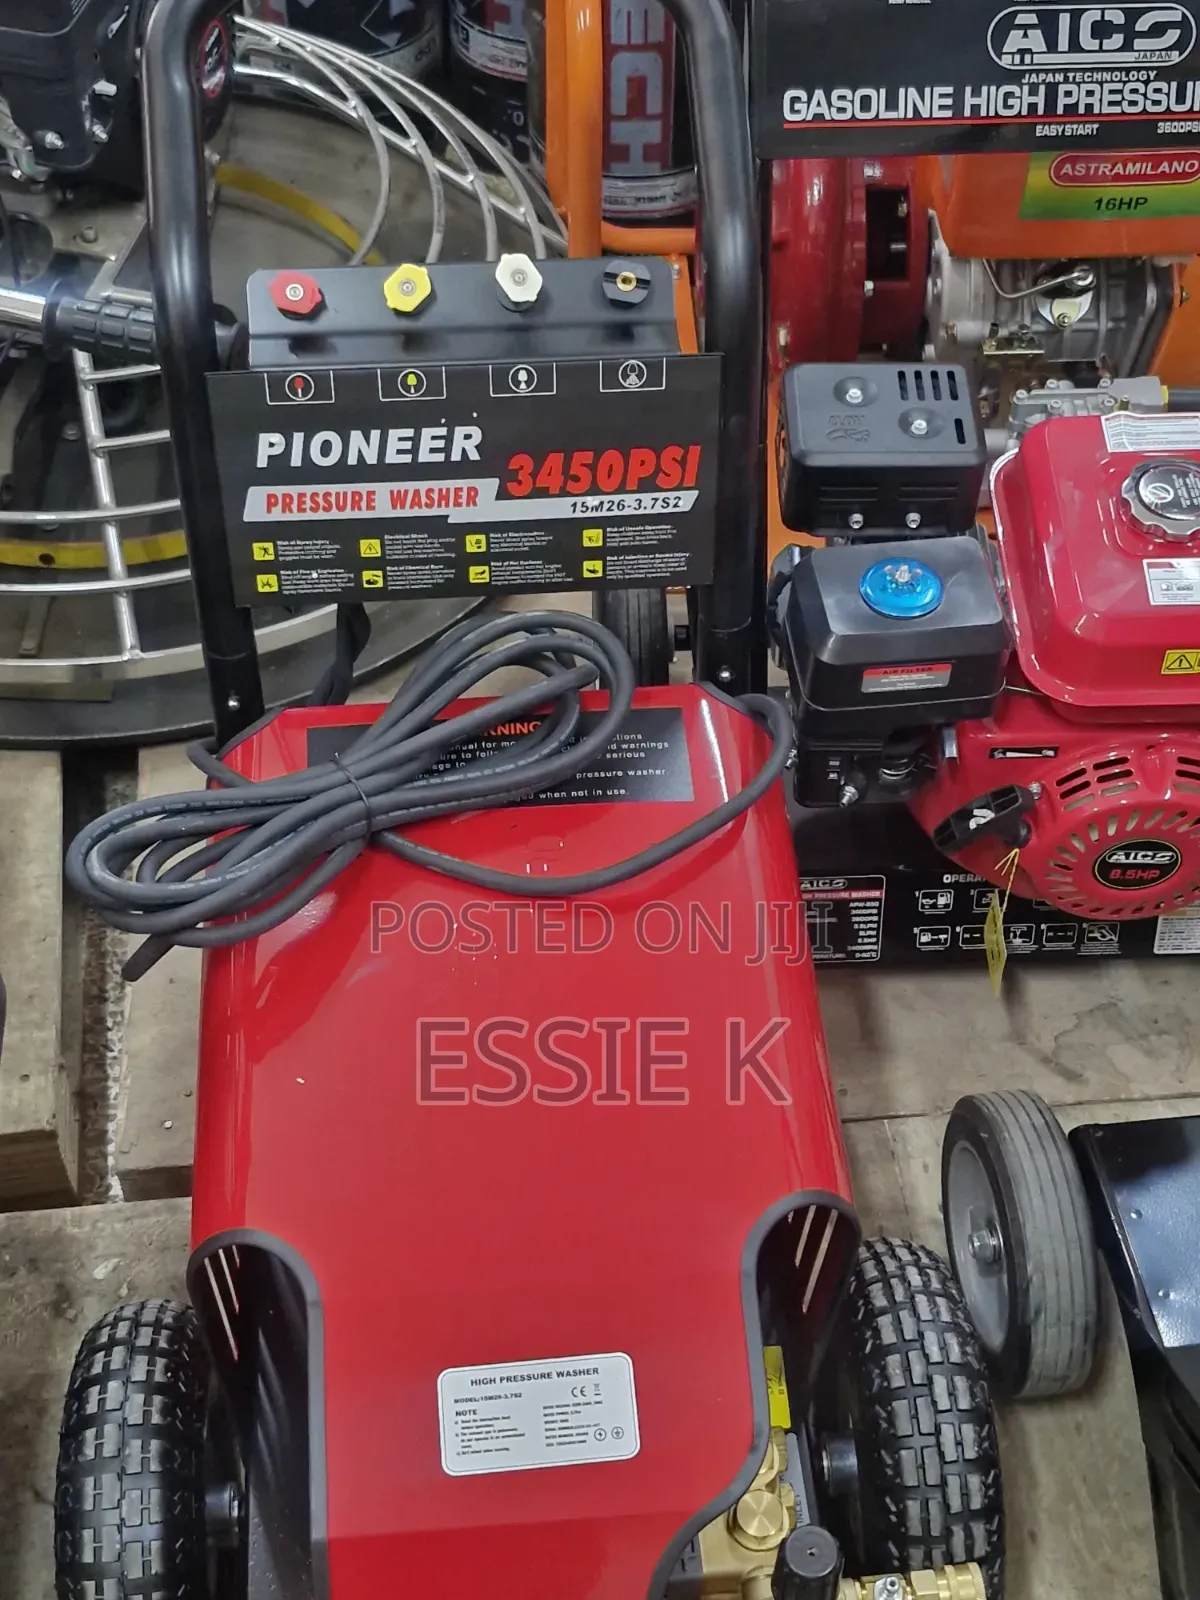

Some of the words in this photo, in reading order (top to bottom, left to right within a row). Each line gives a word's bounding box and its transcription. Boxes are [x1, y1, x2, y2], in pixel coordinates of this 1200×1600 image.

[1002, 9, 1182, 56] AICS
[1134, 52, 1172, 60] JAPAN
[1022, 72, 1064, 84] JAPAN
[1067, 70, 1158, 82] TECHNOLOGY
[783, 86, 954, 122] GASOLINE
[964, 83, 1045, 118] HIGH
[1060, 160, 1199, 176] ASTRAMILANO
[1094, 196, 1148, 211] 16HP
[256, 425, 483, 468] PIONEER
[506, 444, 702, 497] 3450PSI
[266, 490, 376, 514] PRESSURE
[389, 486, 479, 510] WASHER
[570, 495, 682, 514] 15M26-3.7S2
[621, 741, 669, 750] warnings
[606, 751, 646, 759] serious
[576, 769, 623, 779] pressure
[539, 791, 567, 799] when
[571, 789, 588, 797] not
[592, 788, 602, 796] in
[1110, 851, 1173, 863] AICS
[1109, 869, 1161, 879] 8.5HP
[470, 1377, 497, 1387] HIGH
[499, 1371, 553, 1384] PRESSURE
[556, 1367, 599, 1379] WASHER
[455, 1408, 478, 1417] NOTE
